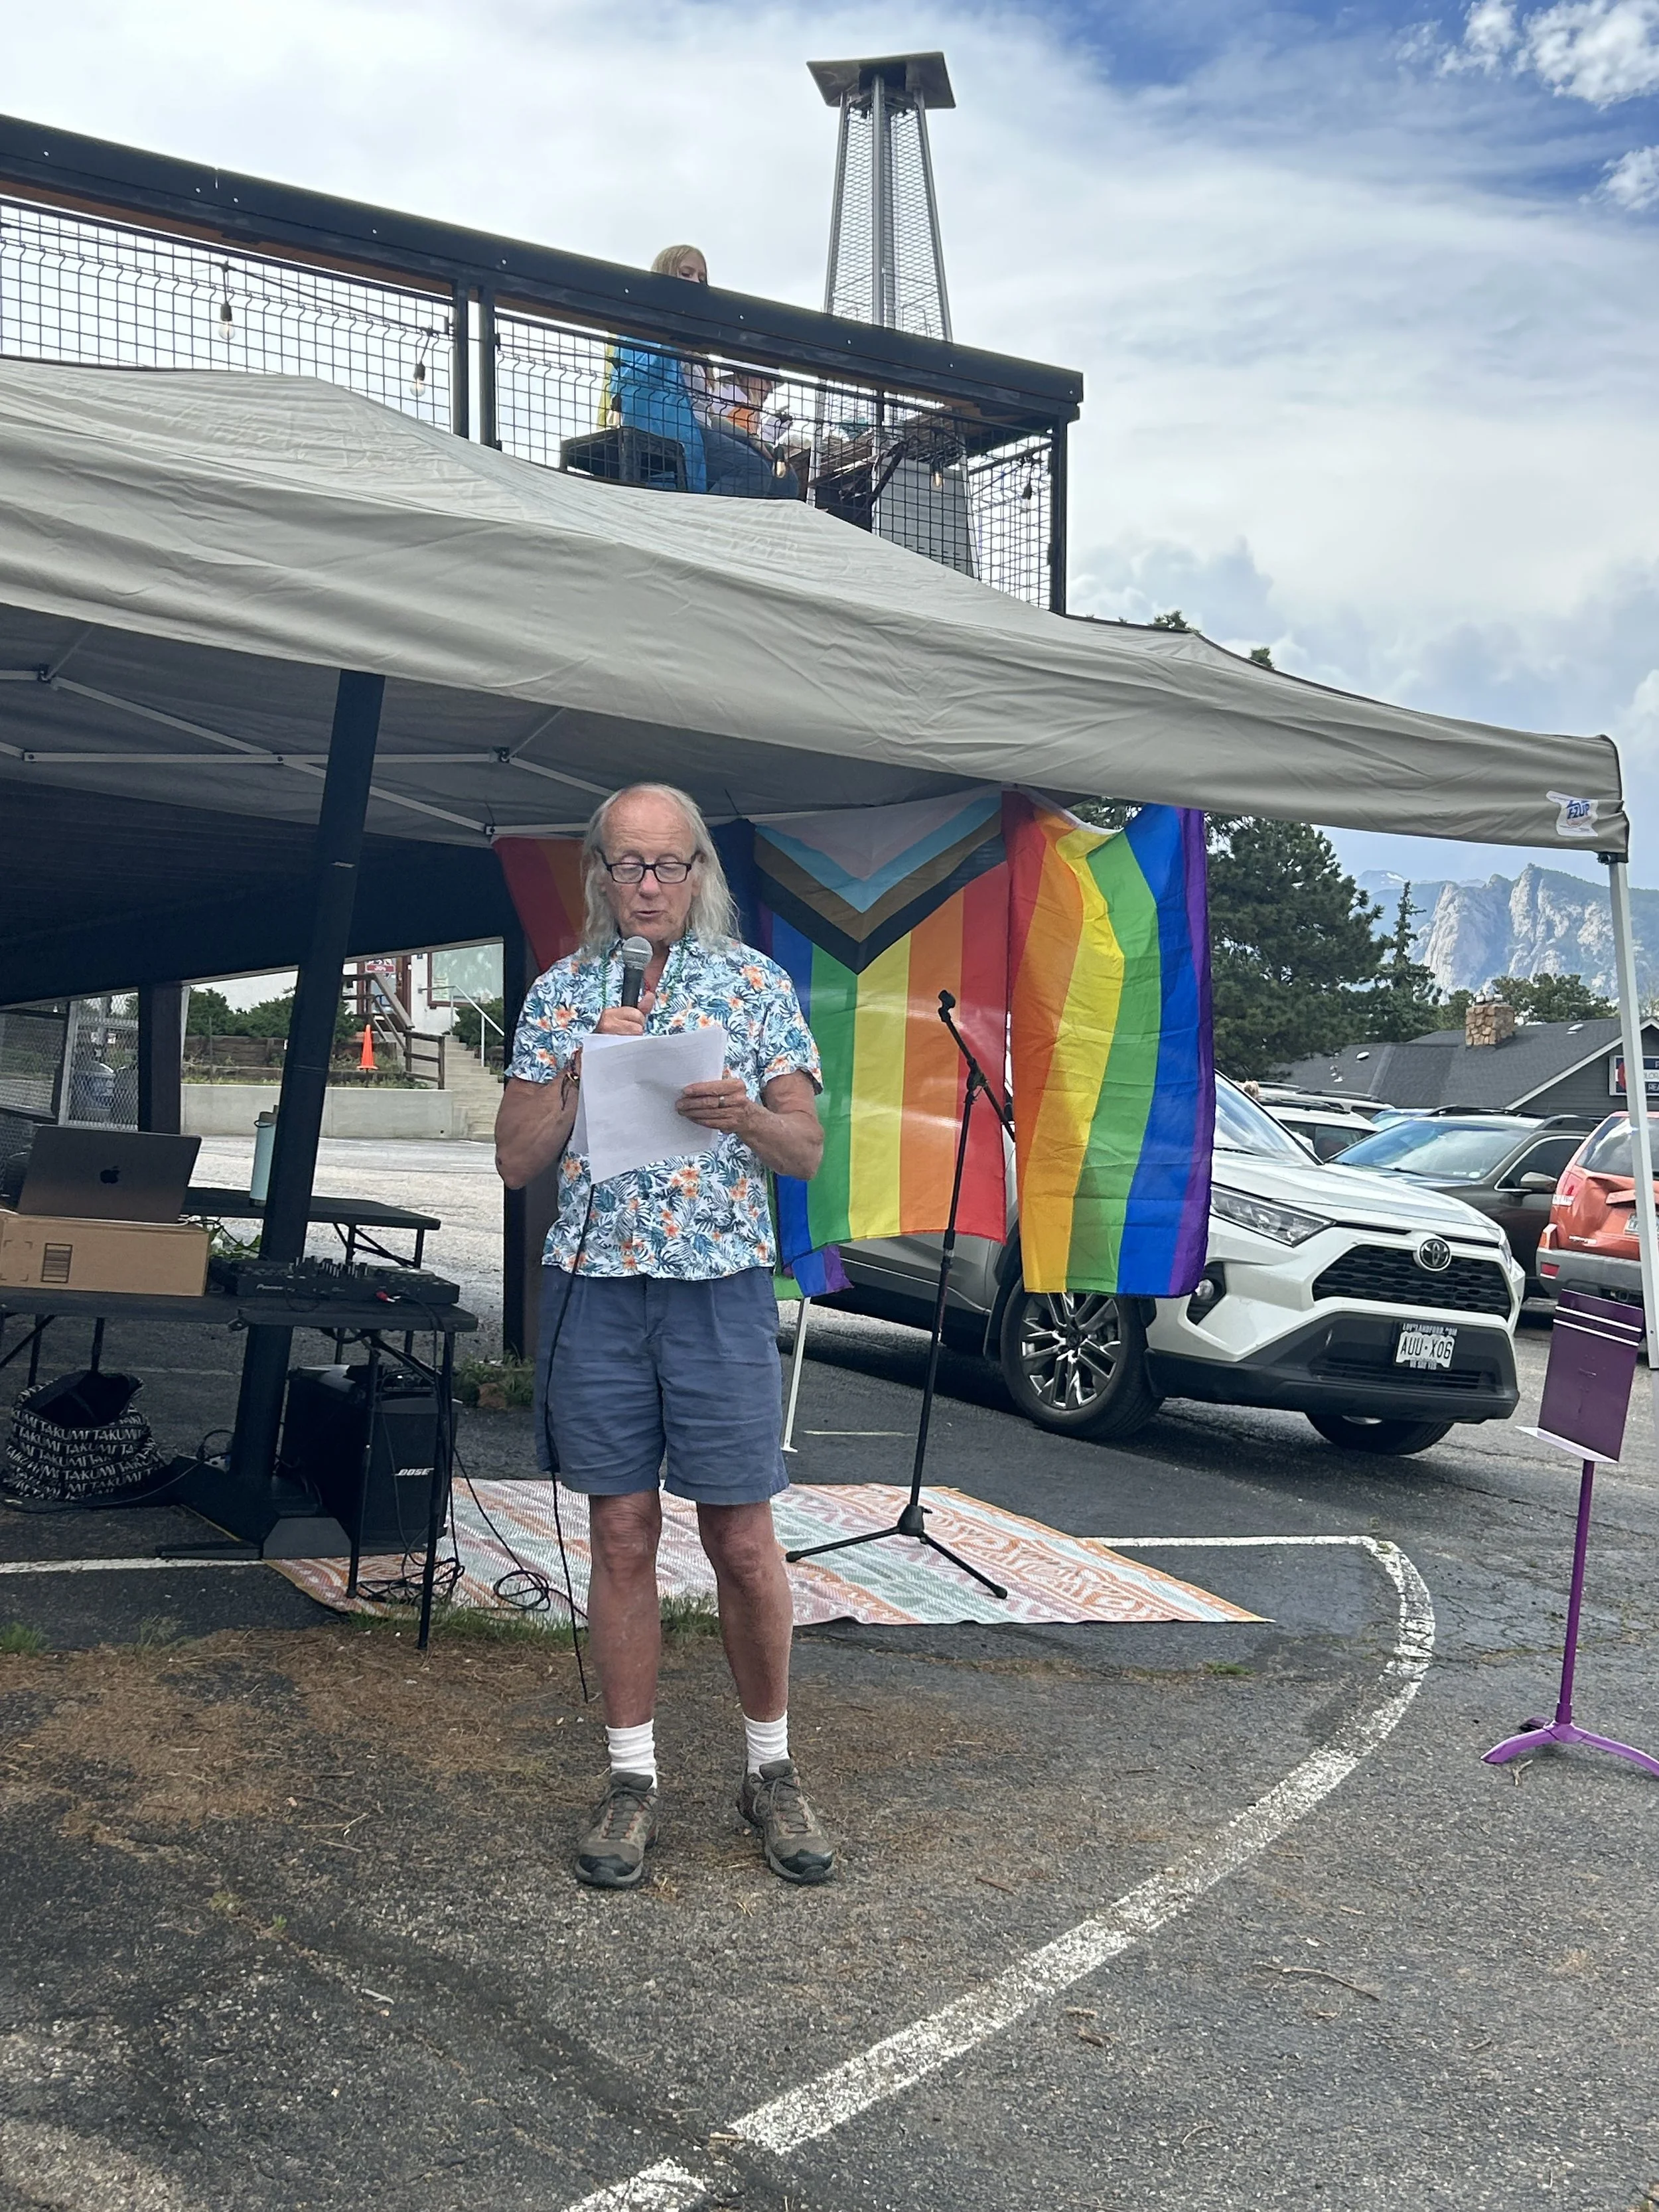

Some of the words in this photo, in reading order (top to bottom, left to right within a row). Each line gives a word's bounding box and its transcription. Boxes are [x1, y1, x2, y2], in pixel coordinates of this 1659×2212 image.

[40, 1420, 89, 1440] TAKUMI
[93, 1428, 142, 1441] TAKUMI
[66, 1443, 117, 1455] TAKUMI
[62, 1464, 115, 1480] TAKUMI
[395, 1467, 435, 1476] BOSE
